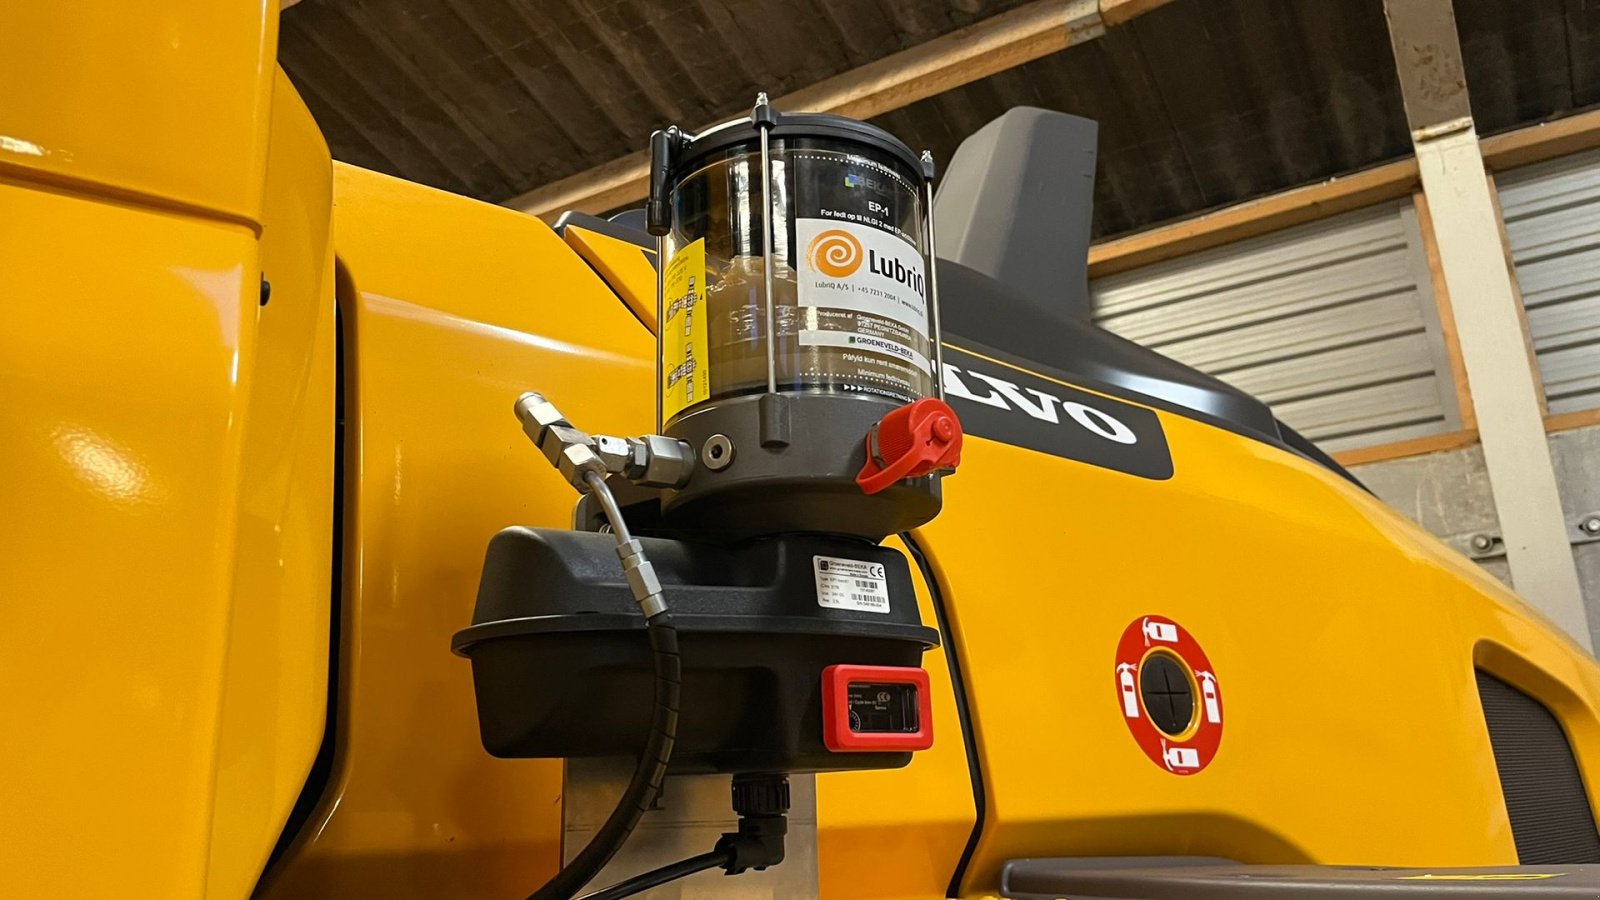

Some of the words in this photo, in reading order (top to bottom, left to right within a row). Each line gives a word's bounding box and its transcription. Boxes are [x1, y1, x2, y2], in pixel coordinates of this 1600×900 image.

[868, 201, 889, 216] EP-1
[820, 209, 832, 217] For
[833, 210, 846, 218] fedt
[863, 216, 878, 225] NLGI
[883, 222, 894, 232] med
[869, 249, 925, 305] LubriQ
[815, 281, 836, 289] LubriQ
[836, 283, 849, 291] A/S
[857, 286, 869, 294] +45
[869, 288, 883, 297] 7231
[857, 327, 885, 338] GERMANY
[856, 337, 913, 357] GROENEVELD-BEKA
[842, 353, 863, 363] Påfyld
[864, 356, 876, 364] kun
[857, 368, 885, 379] Minimum
